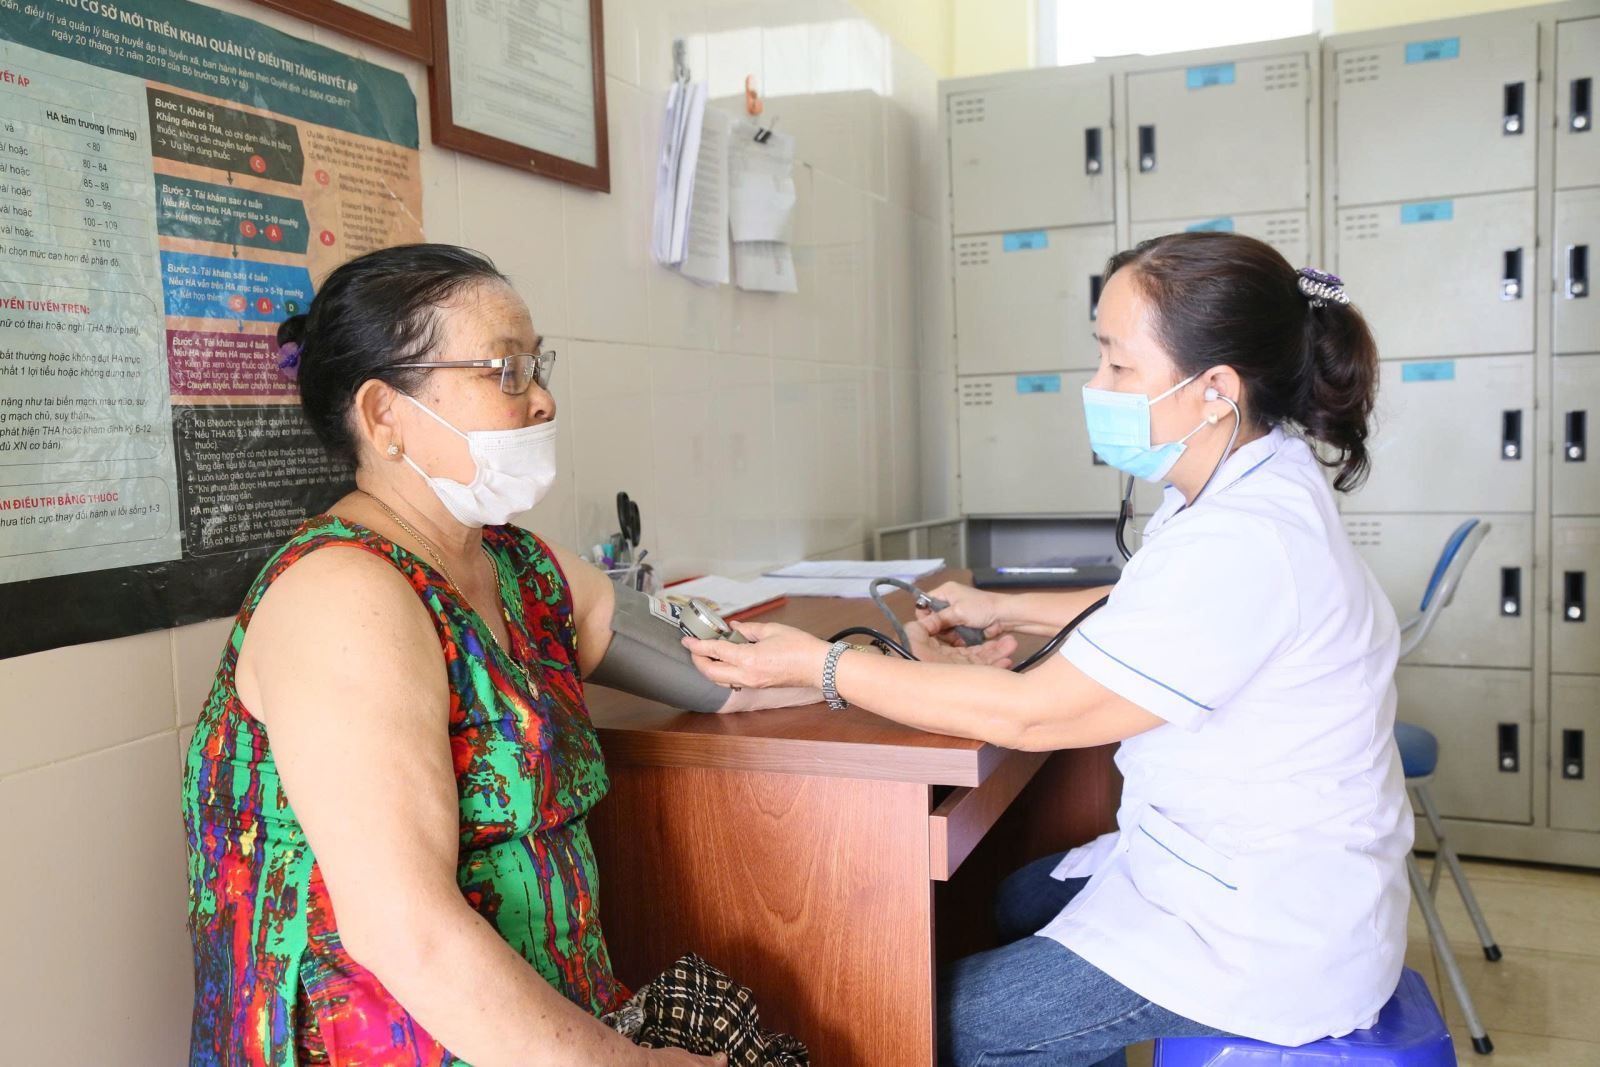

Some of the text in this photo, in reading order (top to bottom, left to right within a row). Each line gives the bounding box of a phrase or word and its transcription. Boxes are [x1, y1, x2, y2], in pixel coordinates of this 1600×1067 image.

[25, 5, 45, 18] điều
[69, 20, 90, 32] quản
[203, 59, 216, 70] ban
[101, 4, 117, 20] SỞ
[120, 10, 144, 28] MỚI
[145, 18, 177, 39] TRIỂN
[180, 30, 207, 48] KHAI
[210, 38, 242, 57] QUẢN
[245, 47, 255, 60] LÝ
[51, 29, 73, 43] ngày
[75, 34, 86, 45] 20
[89, 39, 112, 55] tháng
[115, 48, 124, 57] 12
[127, 51, 144, 61] năm
[146, 55, 166, 67] 2019
[47, 110, 59, 121] HA
[61, 115, 76, 125] tâm
[107, 125, 137, 141] (mmHg)
[9, 143, 28, 155] hoặc
[92, 143, 100, 152] 80
[10, 165, 30, 176] hoặc
[82, 160, 107, 172] 80 84
[83, 179, 109, 191] 85 89
[11, 186, 32, 197] hoặc
[85, 198, 111, 210] 90 99
[179, 200, 191, 209] HA
[221, 206, 232, 215] HA
[13, 205, 32, 217] hoặc
[83, 218, 118, 229] 100 109
[15, 225, 34, 237] hoặc
[271, 229, 277, 237] A
[99, 239, 111, 248] 110
[9, 246, 27, 256] chọn
[14, 320, 25, 328] có
[27, 320, 43, 329] thai
[88, 323, 104, 332] THA
[16, 351, 46, 362] thường
[49, 352, 70, 362] hoặc
[111, 354, 123, 362] HA
[21, 366, 25, 375] 1
[58, 368, 78, 377] hoặc
[44, 398, 54, 406] tai
[9, 413, 32, 422] mạch
[55, 413, 68, 423] suy
[22, 426, 40, 437] hiện
[43, 426, 60, 435] THA
[135, 424, 151, 433] 6-12
[212, 429, 226, 438] THA
[13, 441, 27, 450] XN
[29, 442, 40, 450] cơ
[257, 480, 267, 488] HA
[13, 498, 41, 509] ĐIỀU
[20, 515, 35, 525] tích
[56, 513, 73, 523] thay
[149, 504, 160, 513] 1-3
